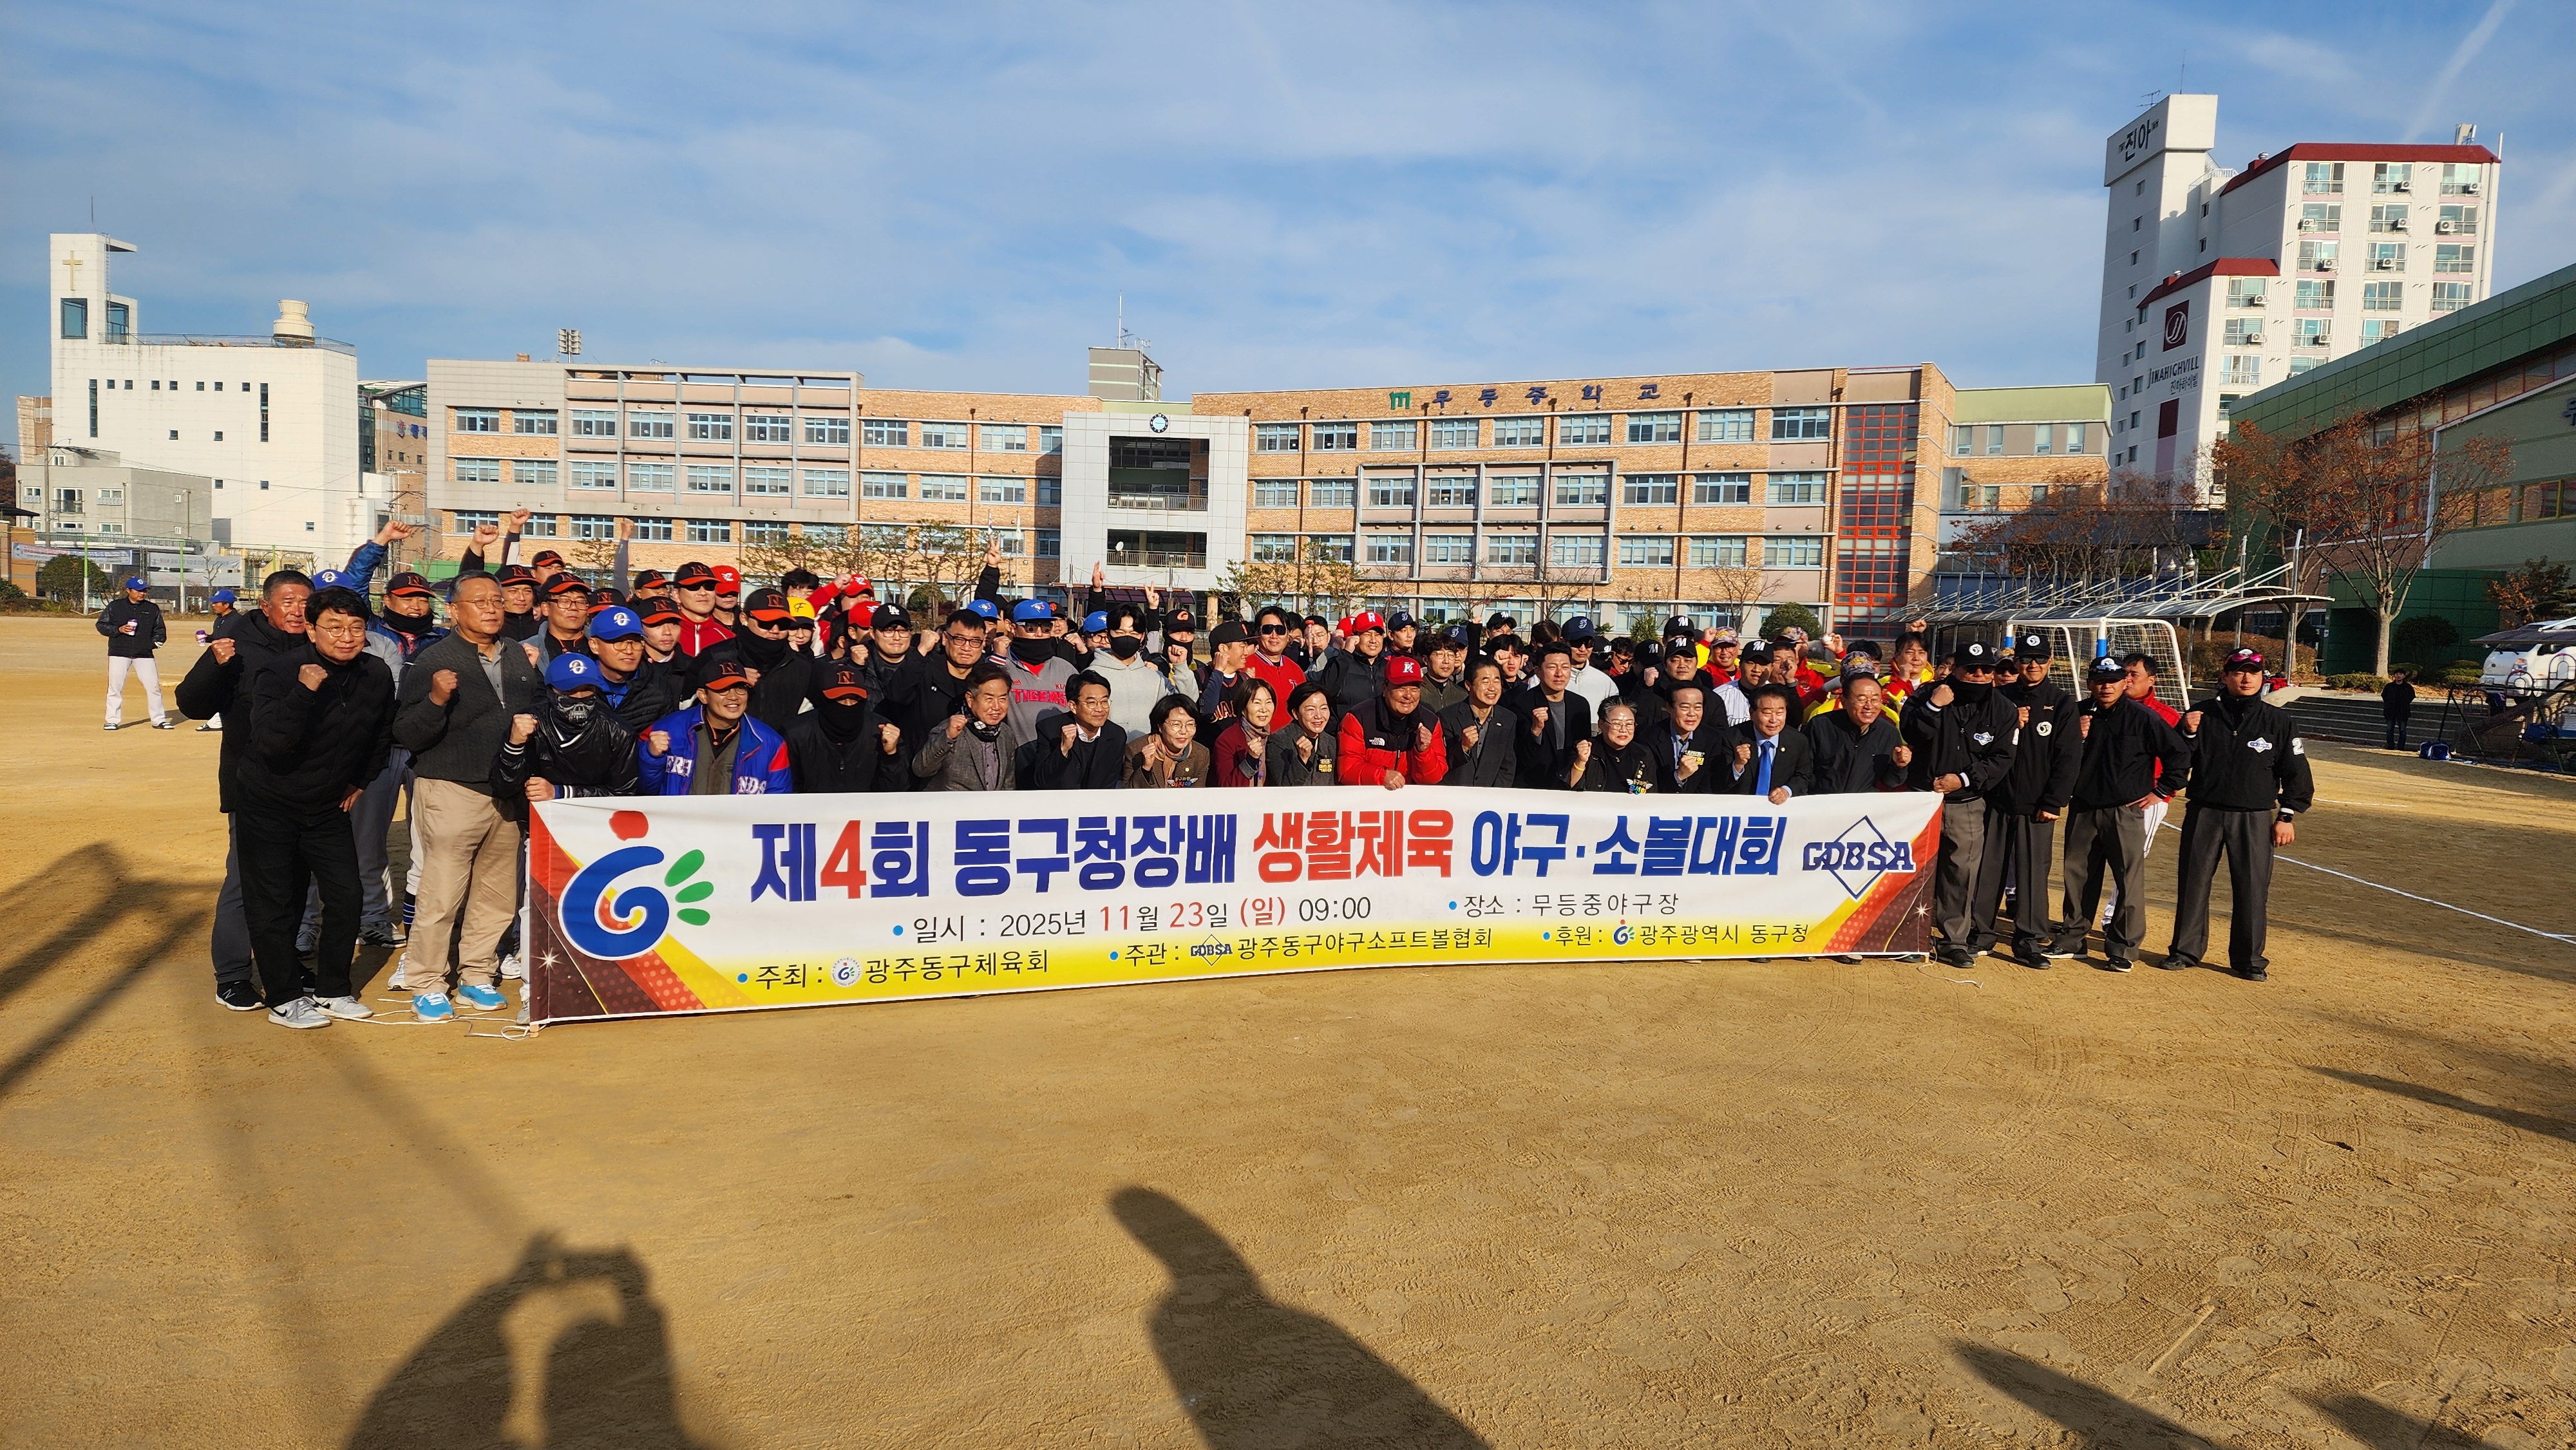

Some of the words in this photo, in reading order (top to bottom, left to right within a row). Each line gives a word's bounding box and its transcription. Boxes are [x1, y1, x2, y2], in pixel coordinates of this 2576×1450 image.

[2125, 119, 2152, 162] 진아
[1432, 383, 1662, 410] 무등중학교
[766, 594, 784, 608] N
[887, 605, 900, 616] LA
[1367, 612, 1376, 623] R
[1678, 616, 1689, 626] M
[1675, 637, 1687, 647] M
[1752, 640, 1766, 652] M
[837, 671, 856, 684] N
[1010, 688, 1067, 708] TIGERS
[751, 820, 929, 902] 제4회
[954, 814, 1237, 897] 동구청장배
[1253, 809, 1454, 883] 생활체육
[1803, 841, 1916, 872] GDBSA
[1464, 894, 1504, 918] 장소
[1532, 893, 1680, 917] 무등중야구장
[914, 915, 964, 943] 일시
[1000, 909, 1085, 937] 2025년
[1102, 906, 1159, 932] 11월
[1170, 901, 1227, 928] 23일
[1240, 897, 1286, 926] (일)
[1299, 896, 1371, 922] 09:00
[1555, 926, 1592, 947] 후원
[1640, 924, 1739, 946] 광주광역시
[1750, 923, 1808, 944] 동구청
[1124, 943, 1167, 967] 주관
[1190, 943, 1233, 958] GDBSA
[1237, 928, 1492, 960] 광주동구야구소프트볼협회
[755, 963, 806, 990] 주최
[865, 949, 1048, 984] 광주동구체육회
